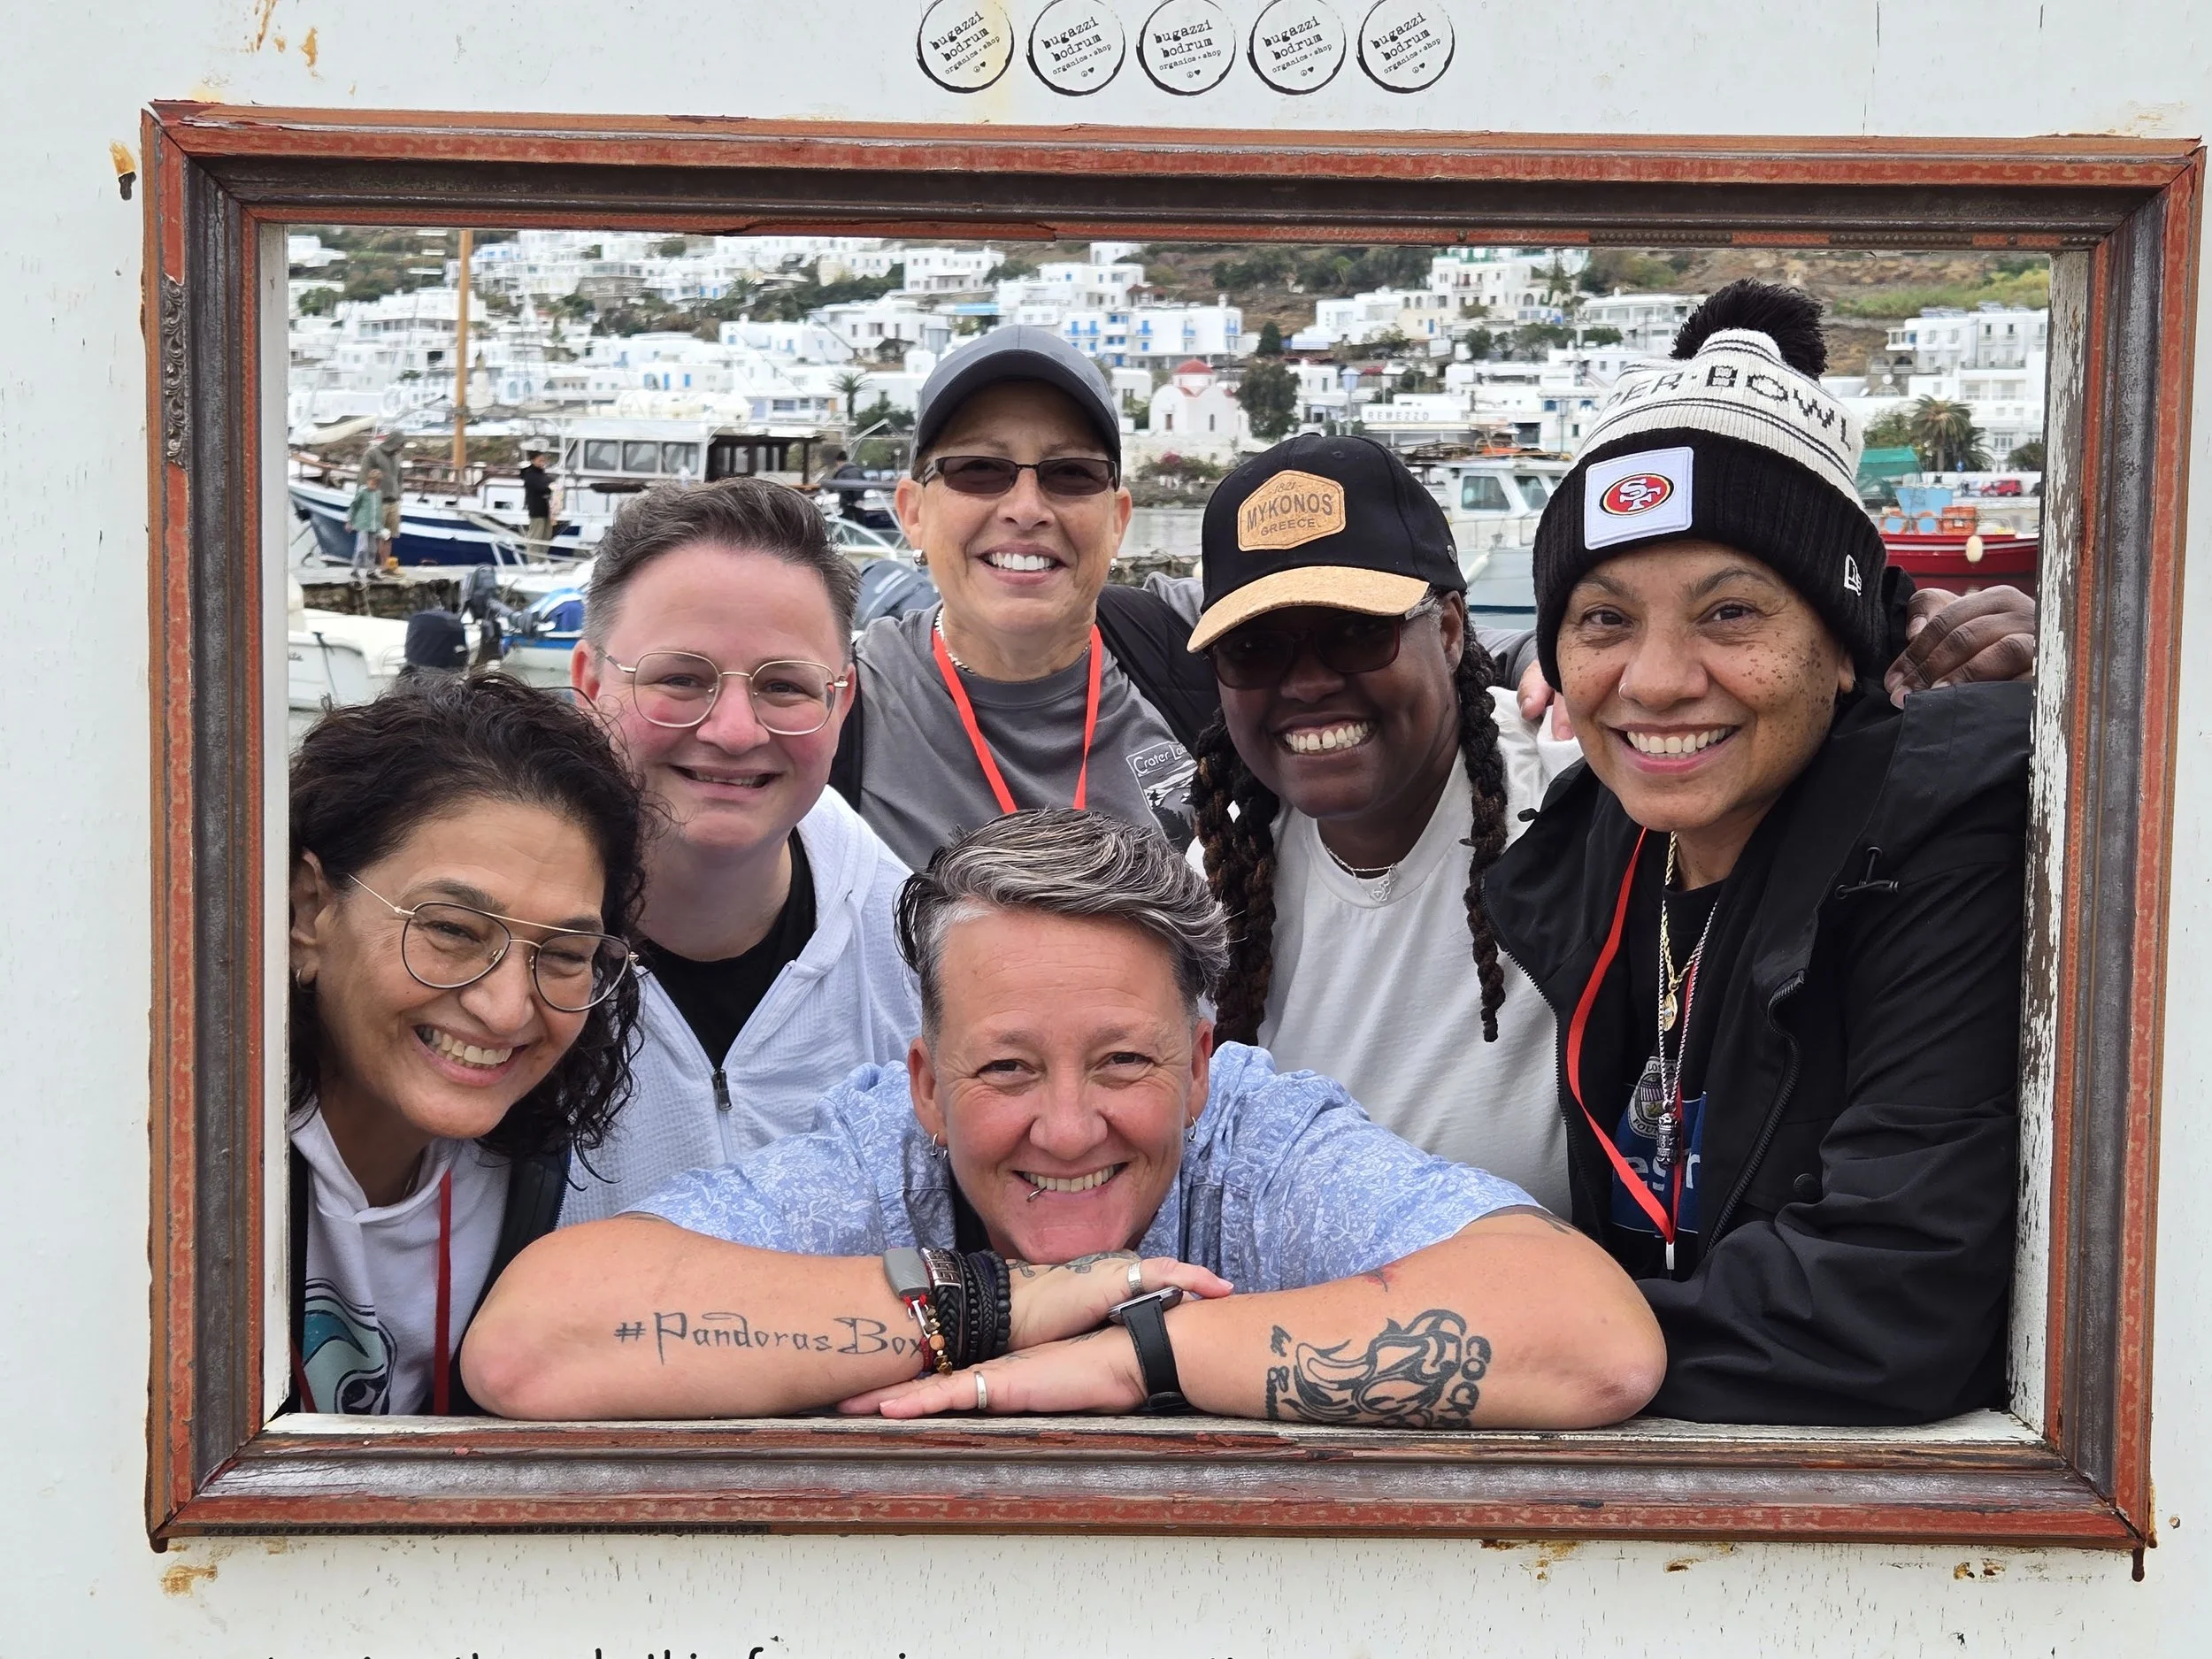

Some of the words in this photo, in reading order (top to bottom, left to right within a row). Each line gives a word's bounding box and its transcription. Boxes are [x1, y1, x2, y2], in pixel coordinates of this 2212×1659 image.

[929, 11, 984, 50] bugazzi
[941, 26, 990, 62] bodrum
[1041, 16, 1099, 49] bugazzi
[1153, 19, 1213, 44] bugazzi
[1161, 35, 1213, 58] bodrum
[1262, 15, 1320, 47] bugazzi
[1271, 32, 1323, 60] bodrum
[1370, 12, 1426, 50] bugazzi
[1381, 27, 1431, 61] bodrum
[1051, 32, 1102, 63] bodrum
[1705, 365, 1852, 452] BOWL
[1247, 493, 1333, 533] MYKONOS
[1260, 518, 1316, 536] GREECE
[1133, 750, 1170, 774] Crater
